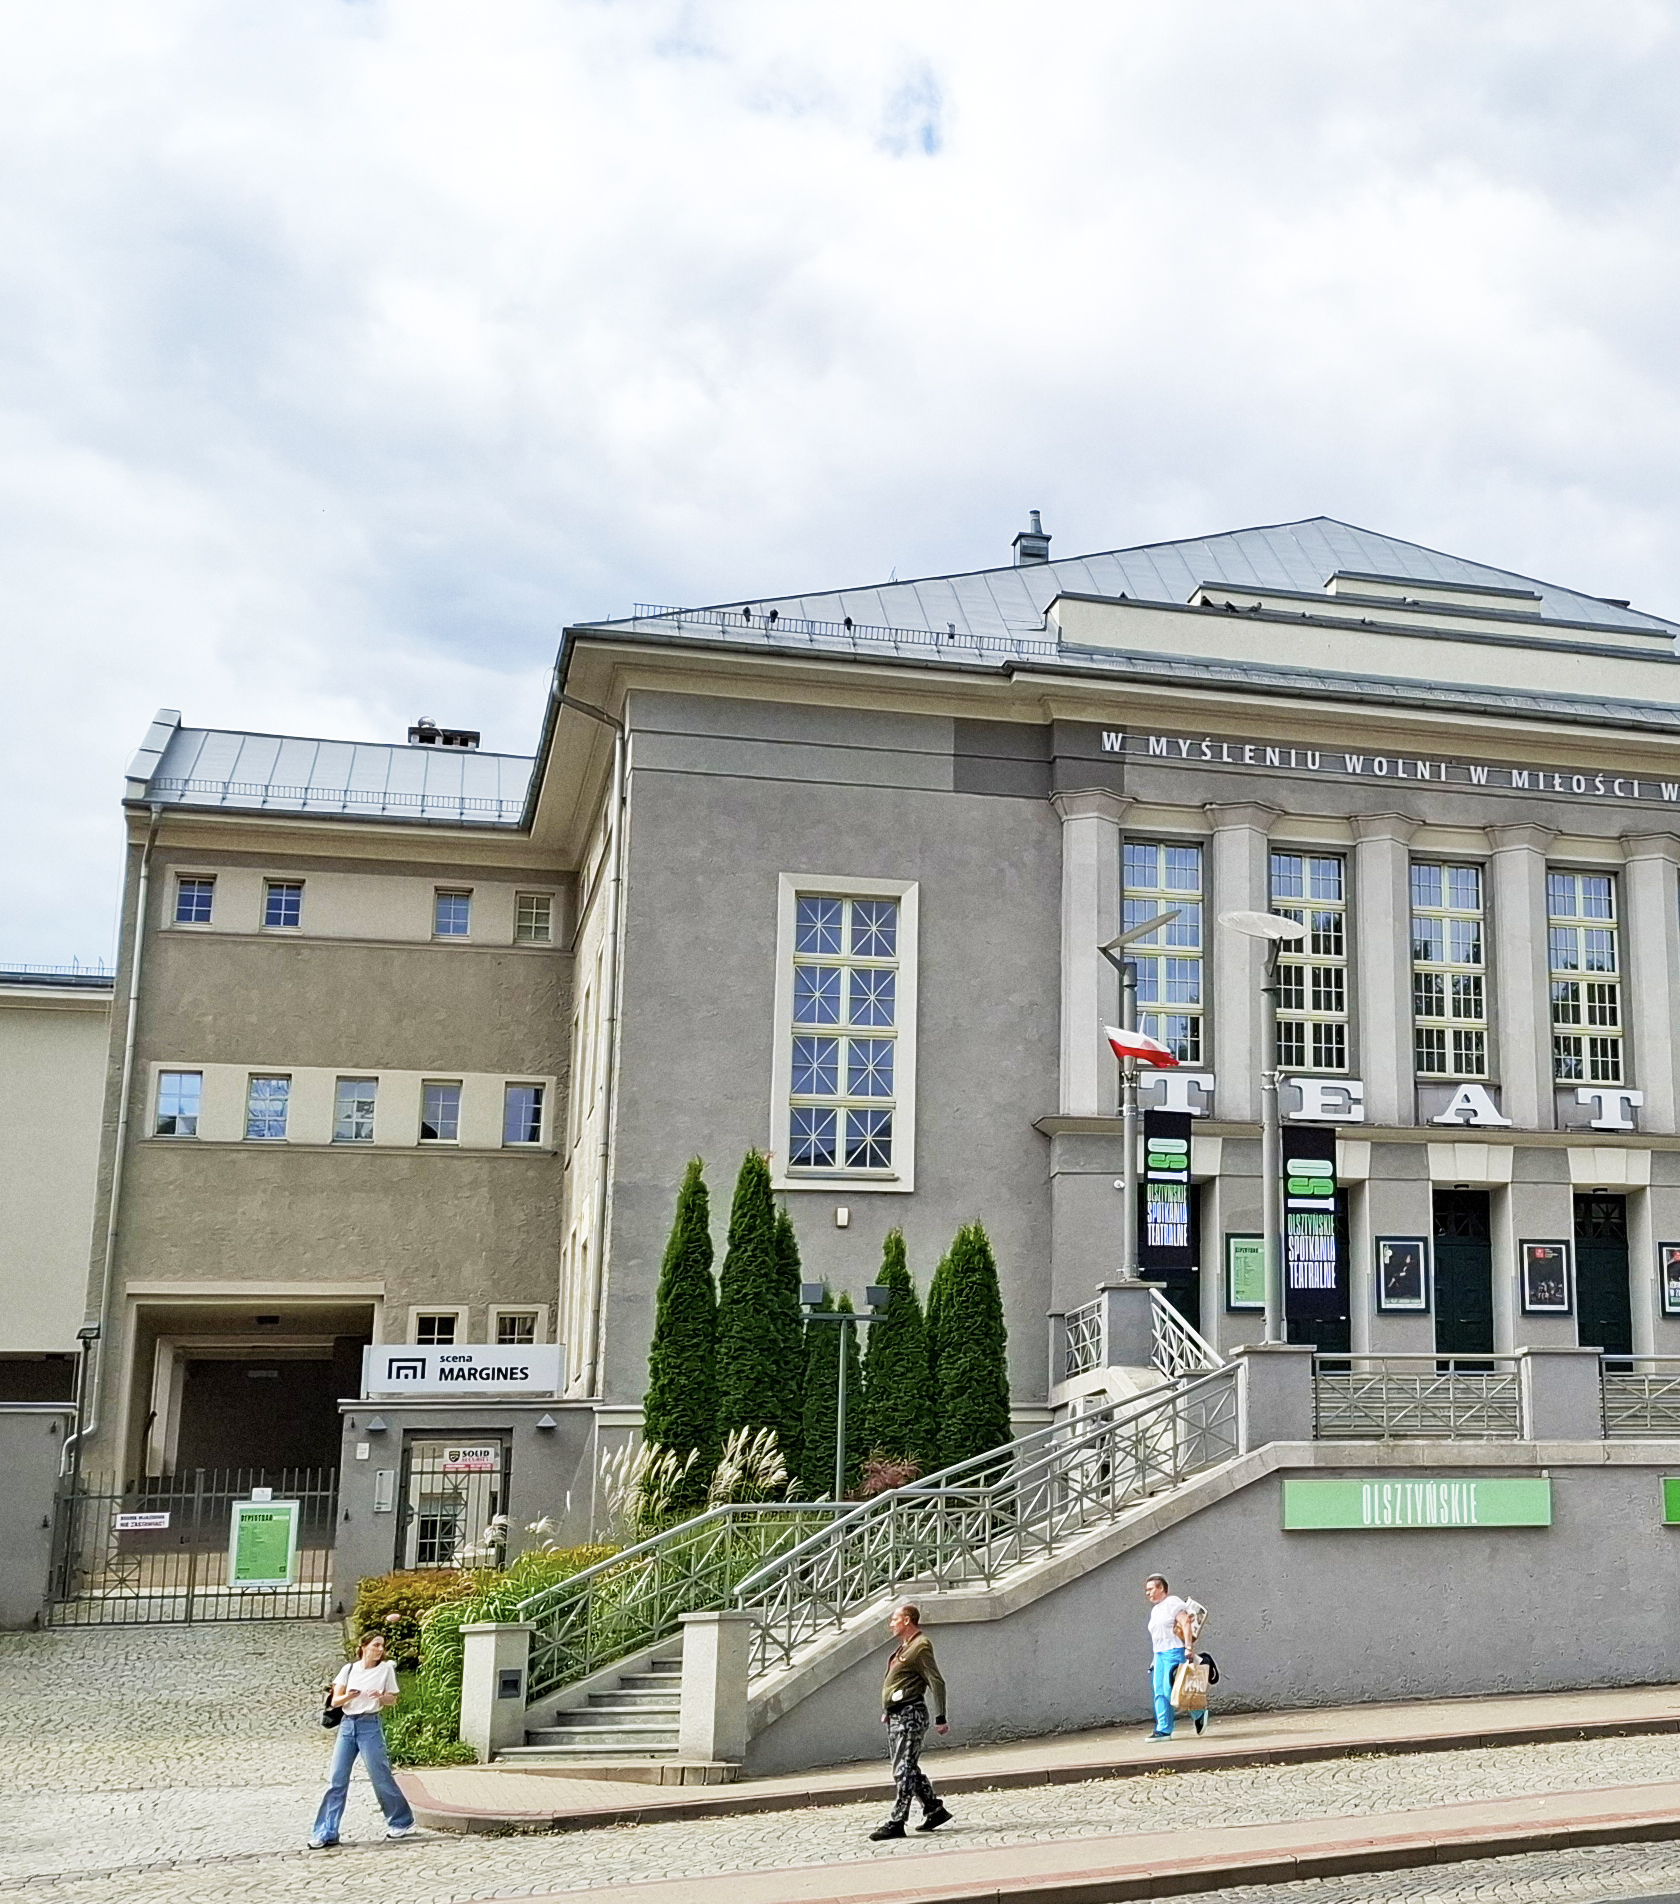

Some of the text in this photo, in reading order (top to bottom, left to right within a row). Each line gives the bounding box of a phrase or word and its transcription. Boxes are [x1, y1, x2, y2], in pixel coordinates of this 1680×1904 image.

[1102, 731, 1122, 751] W
[1149, 736, 1320, 770] MYŚLENIU
[1345, 754, 1446, 781] WOLNI
[1470, 766, 1488, 785] W
[1511, 770, 1640, 798] MIŁOŚCI
[1289, 1235, 1336, 1261] SPOTKANIA
[1289, 1261, 1336, 1289] TEATRALNE
[439, 1354, 473, 1363] scena
[438, 1366, 529, 1381] MARGINES
[462, 1450, 490, 1458] SOLID
[1362, 1480, 1478, 1525] OLSZTYŃSKIE
